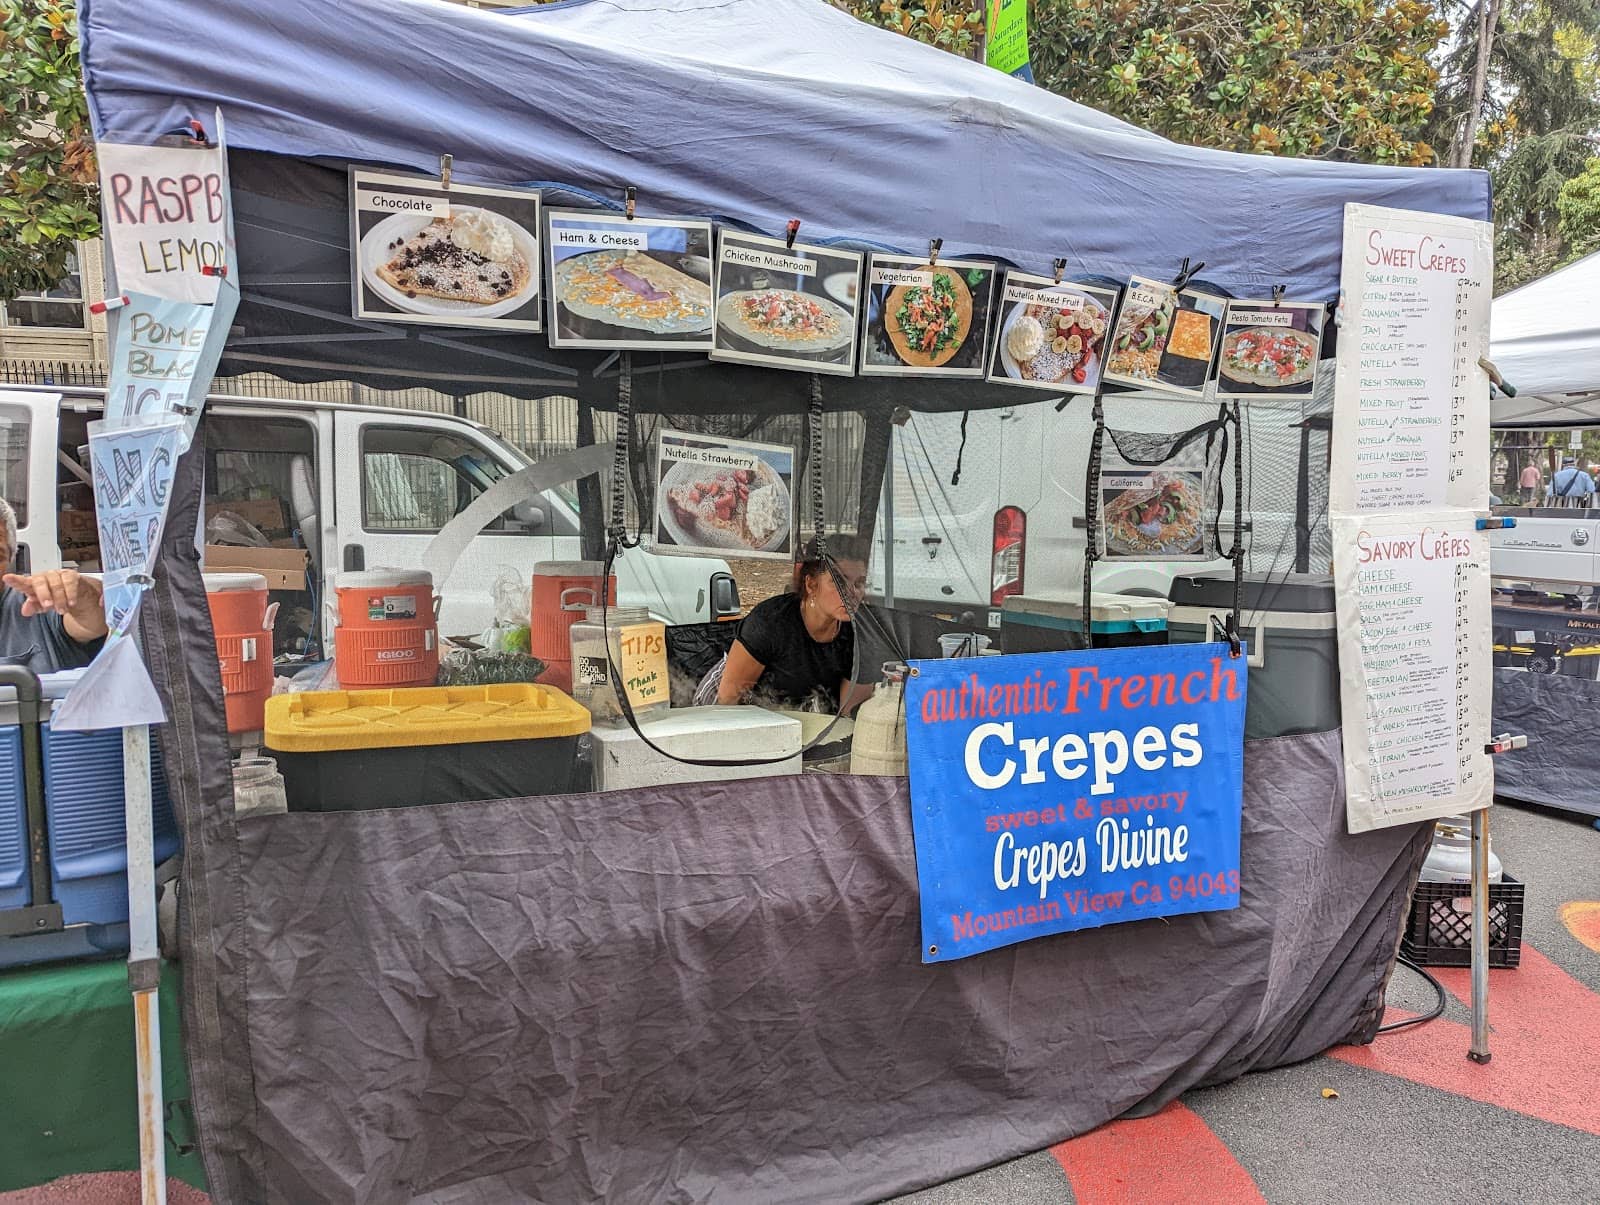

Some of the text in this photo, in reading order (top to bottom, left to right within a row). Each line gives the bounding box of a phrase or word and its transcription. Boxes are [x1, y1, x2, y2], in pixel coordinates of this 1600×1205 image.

[371, 195, 433, 212] Chocolate
[559, 231, 641, 247] Ham & Cheese
[1366, 230, 1416, 268] SWEET
[724, 249, 813, 273] Chicken Mushroom
[878, 271, 923, 284] Vegetarian
[1392, 275, 1418, 285] BUTTER
[1008, 289, 1081, 308] Nutella Mixed Fruit
[1231, 312, 1289, 325] Pesto Tomato Feta
[1360, 342, 1404, 352] CHOCOLATE
[1360, 359, 1397, 369] NUTELLA
[1360, 378, 1426, 388] FRESH STRAWBERRY
[1360, 399, 1383, 409] MIXED
[665, 447, 754, 469] Nutella Strawberry
[1110, 478, 1144, 488] California
[1357, 530, 1416, 563] SAVORY
[1358, 569, 1396, 582] CHEESE
[1358, 584, 1378, 595] HAM
[1384, 582, 1413, 593] CHEESE
[1375, 599, 1392, 608] HAM
[1396, 596, 1424, 607] CHEESE
[1407, 621, 1433, 632] CHEESE
[621, 634, 663, 656] TIPS
[1380, 642, 1406, 651] TOMATO
[377, 650, 414, 659] IGLOO
[627, 671, 658, 691] Thank
[921, 657, 1241, 724] authentic French
[1387, 703, 1423, 716] FAVORITE
[964, 721, 1203, 796] Crepes
[985, 791, 1189, 833] sweet & savory
[993, 814, 1189, 899] Crepes Divine
[951, 869, 1241, 942] Mountain View Ca 94043
